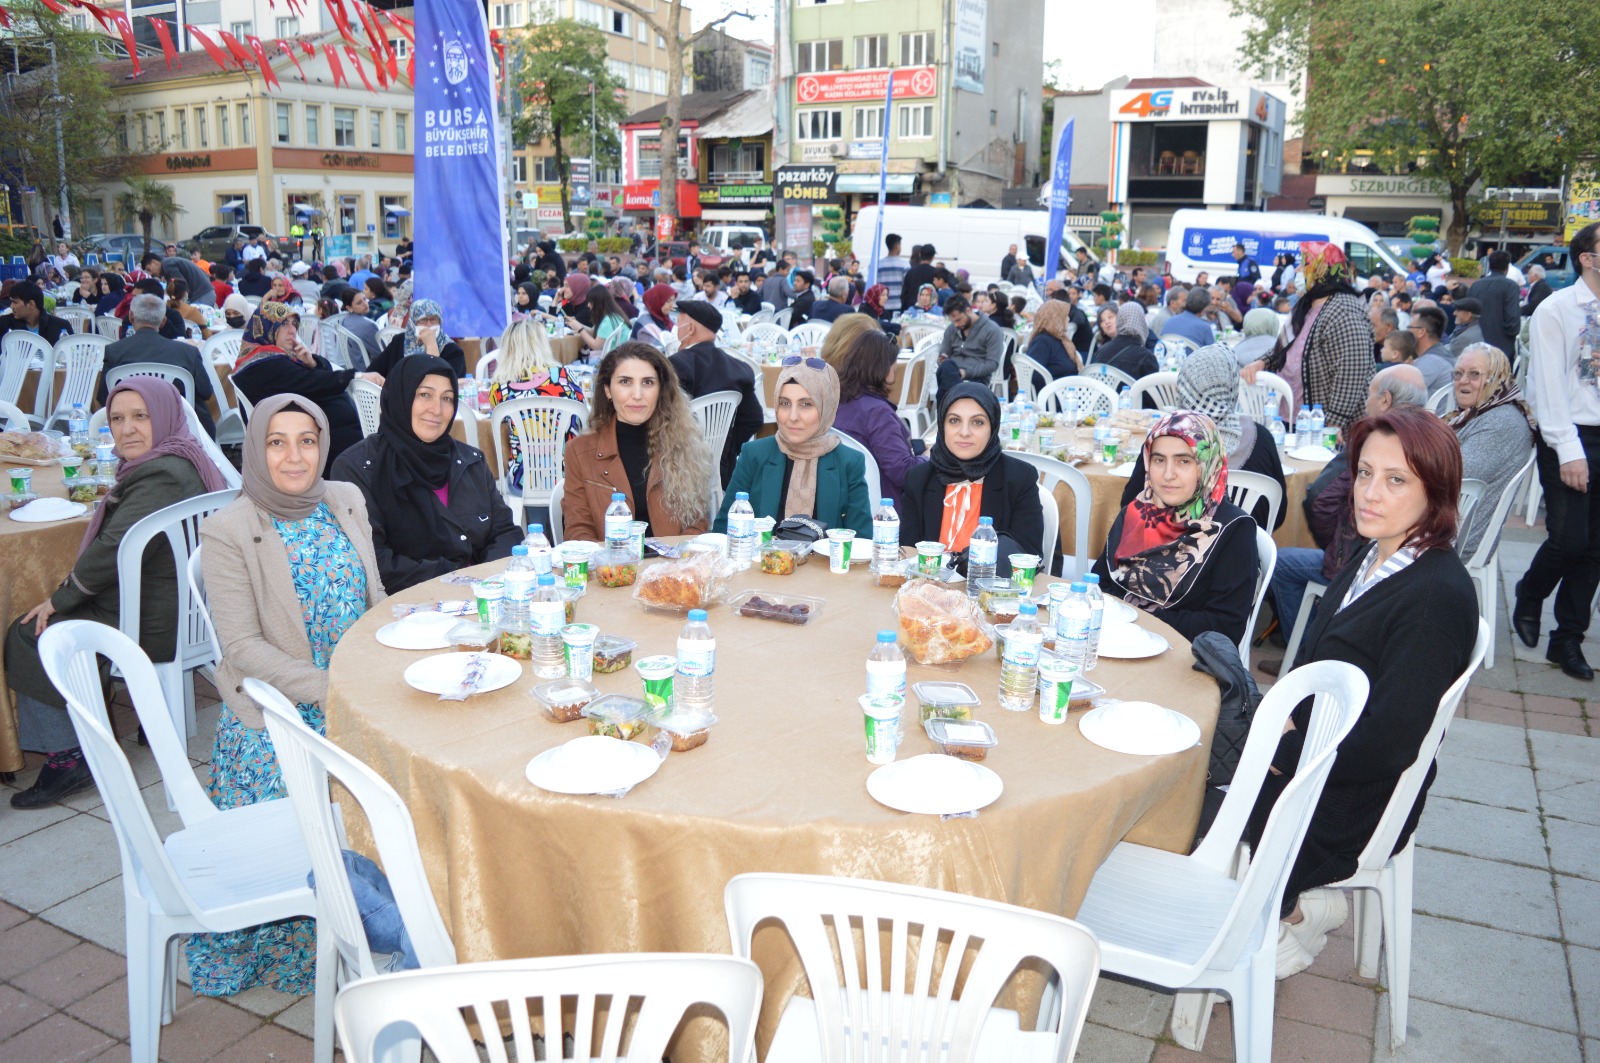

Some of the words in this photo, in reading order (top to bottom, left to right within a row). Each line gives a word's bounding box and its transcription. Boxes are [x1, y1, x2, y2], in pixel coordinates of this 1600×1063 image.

[884, 79, 910, 88] PRTİSİ
[1119, 90, 1174, 117] 4G
[1192, 91, 1207, 101] EV
[425, 107, 487, 128] BURSA
[425, 125, 487, 142] BÜYÜKŞEHİR
[425, 140, 488, 158] BELEDİYESİ
[777, 168, 835, 186] pazarköy
[783, 184, 828, 199] DÖNER
